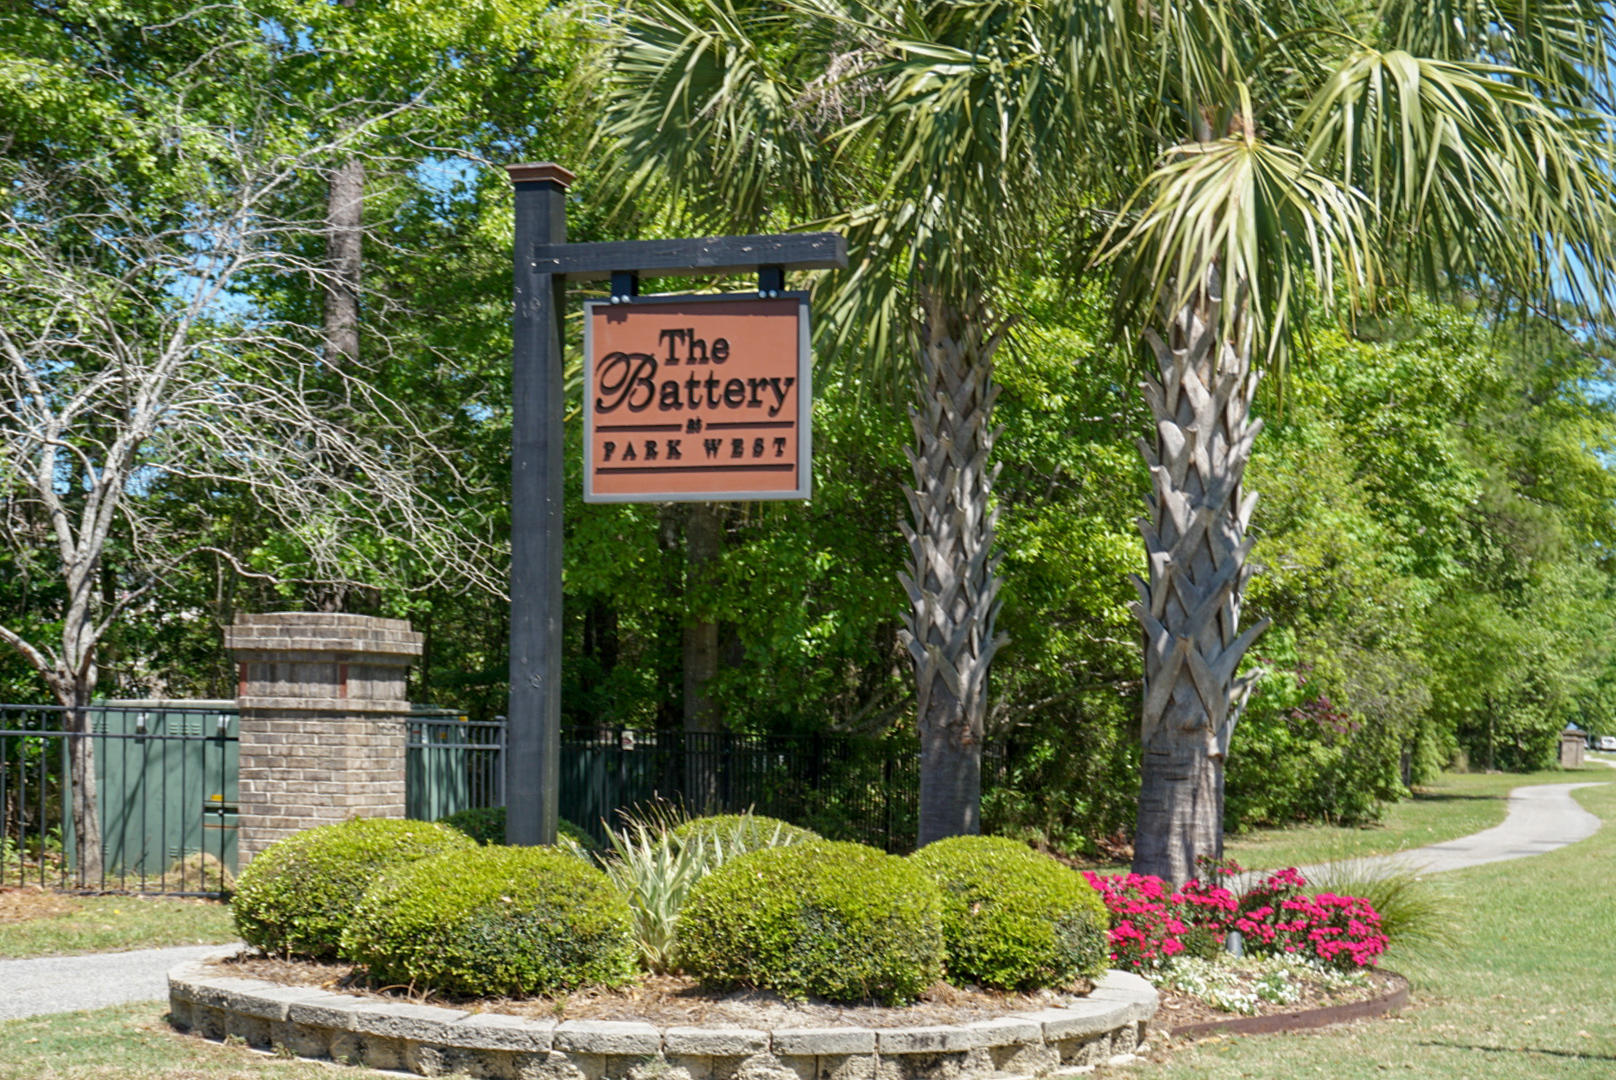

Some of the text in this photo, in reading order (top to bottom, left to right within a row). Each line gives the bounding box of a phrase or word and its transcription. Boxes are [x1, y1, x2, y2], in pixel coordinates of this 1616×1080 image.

[659, 328, 730, 365] The
[595, 351, 795, 417] Battery
[686, 417, 703, 434] at
[603, 437, 786, 461] PARK WEST
